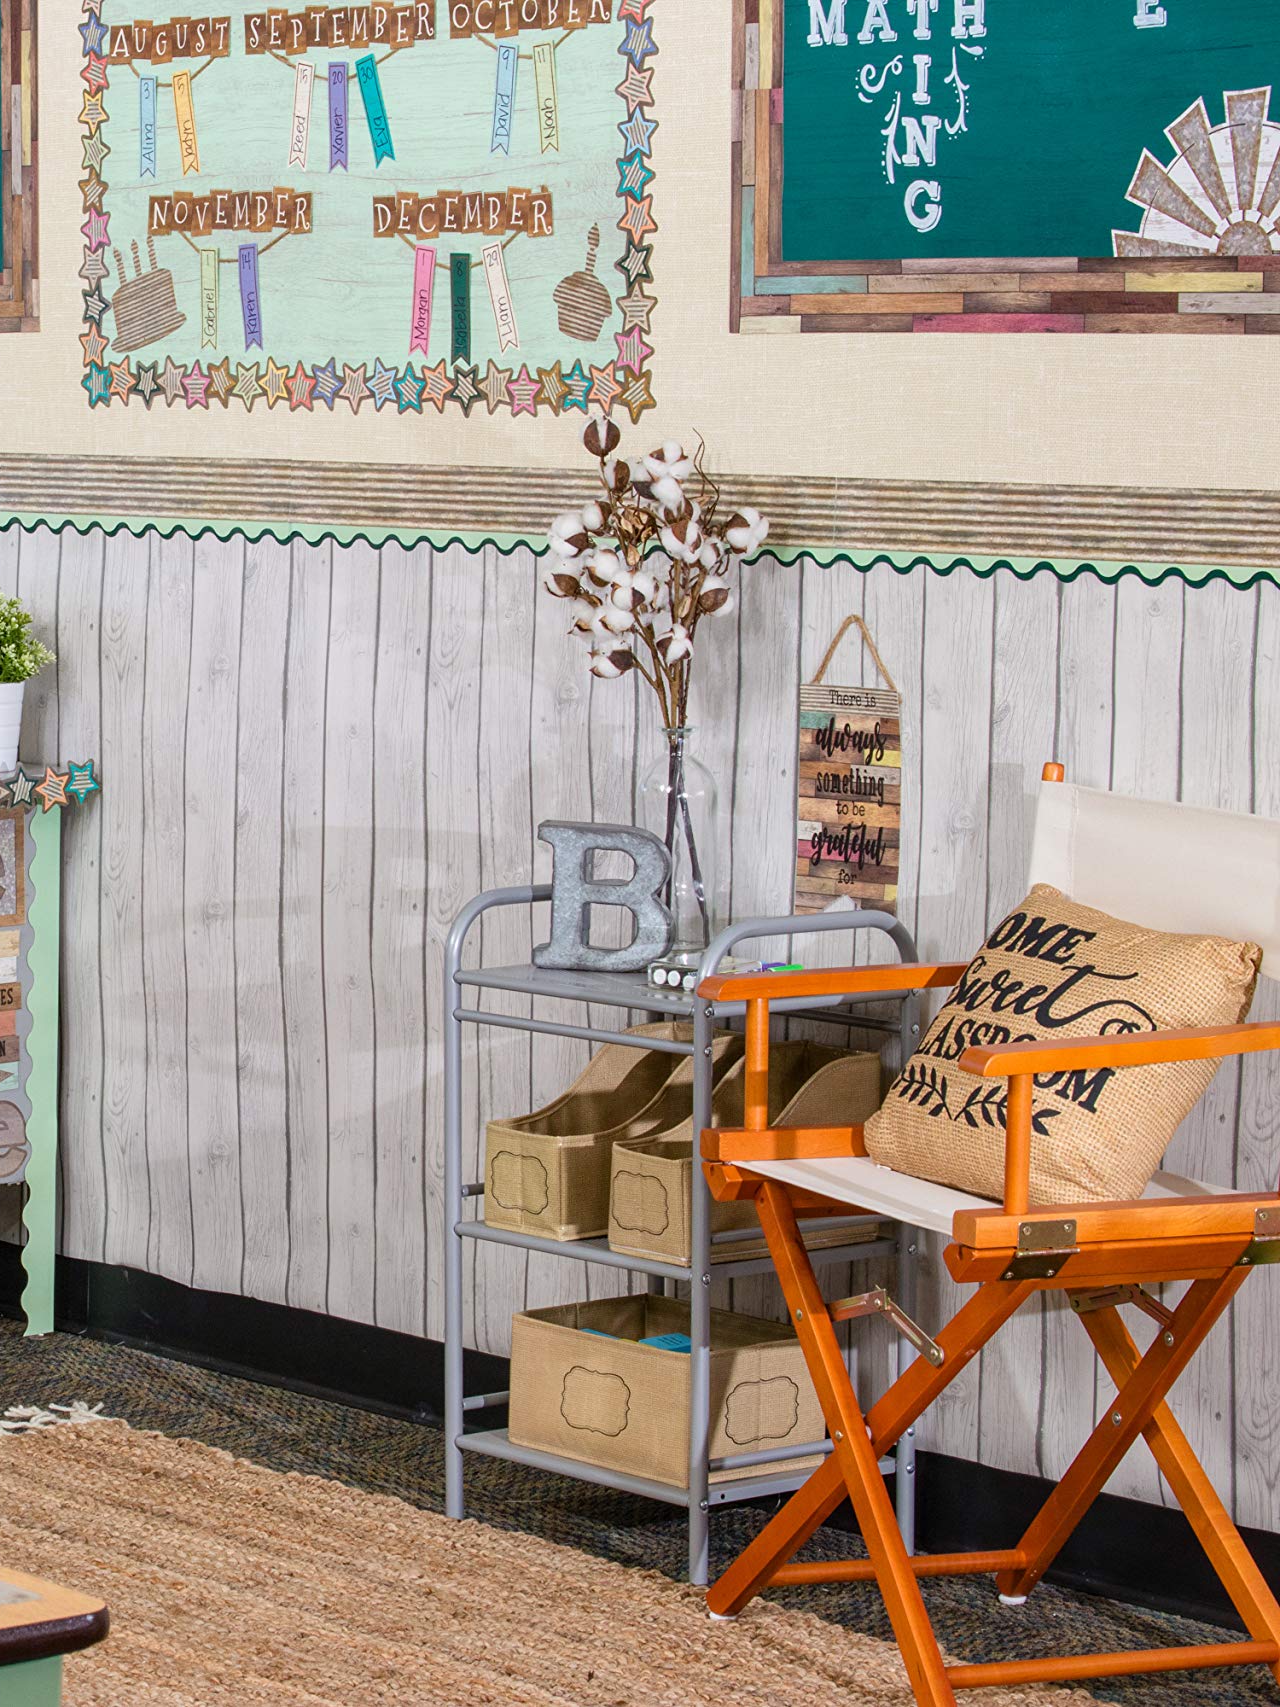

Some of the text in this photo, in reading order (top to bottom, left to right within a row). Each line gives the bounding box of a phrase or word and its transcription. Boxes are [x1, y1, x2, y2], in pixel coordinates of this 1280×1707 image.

[111, 22, 229, 57] AUGUST
[249, 3, 434, 48] SEPTEMBER
[807, 0, 987, 47] MATH
[144, 82, 150, 99] 3
[332, 70, 342, 84] 20
[292, 114, 306, 154] Reed
[333, 106, 345, 155] Xavier
[375, 115, 389, 148] Eva
[494, 92, 510, 138] David
[543, 97, 556, 139] Noah
[141, 122, 154, 163] Alina
[152, 193, 310, 231] NOVEMBER
[375, 192, 552, 235] DECEMBER
[203, 287, 216, 337] Gabriel
[247, 290, 259, 335] Karen
[413, 288, 429, 341] Morgan
[496, 296, 514, 338] Liam
[829, 689, 876, 708] There is
[815, 716, 887, 763] always
[816, 769, 885, 806] something
[835, 801, 866, 816] to be
[811, 823, 887, 870] grateful
[531, 820, 675, 973] B
[837, 870, 856, 885] for
[987, 912, 1096, 966] OME
